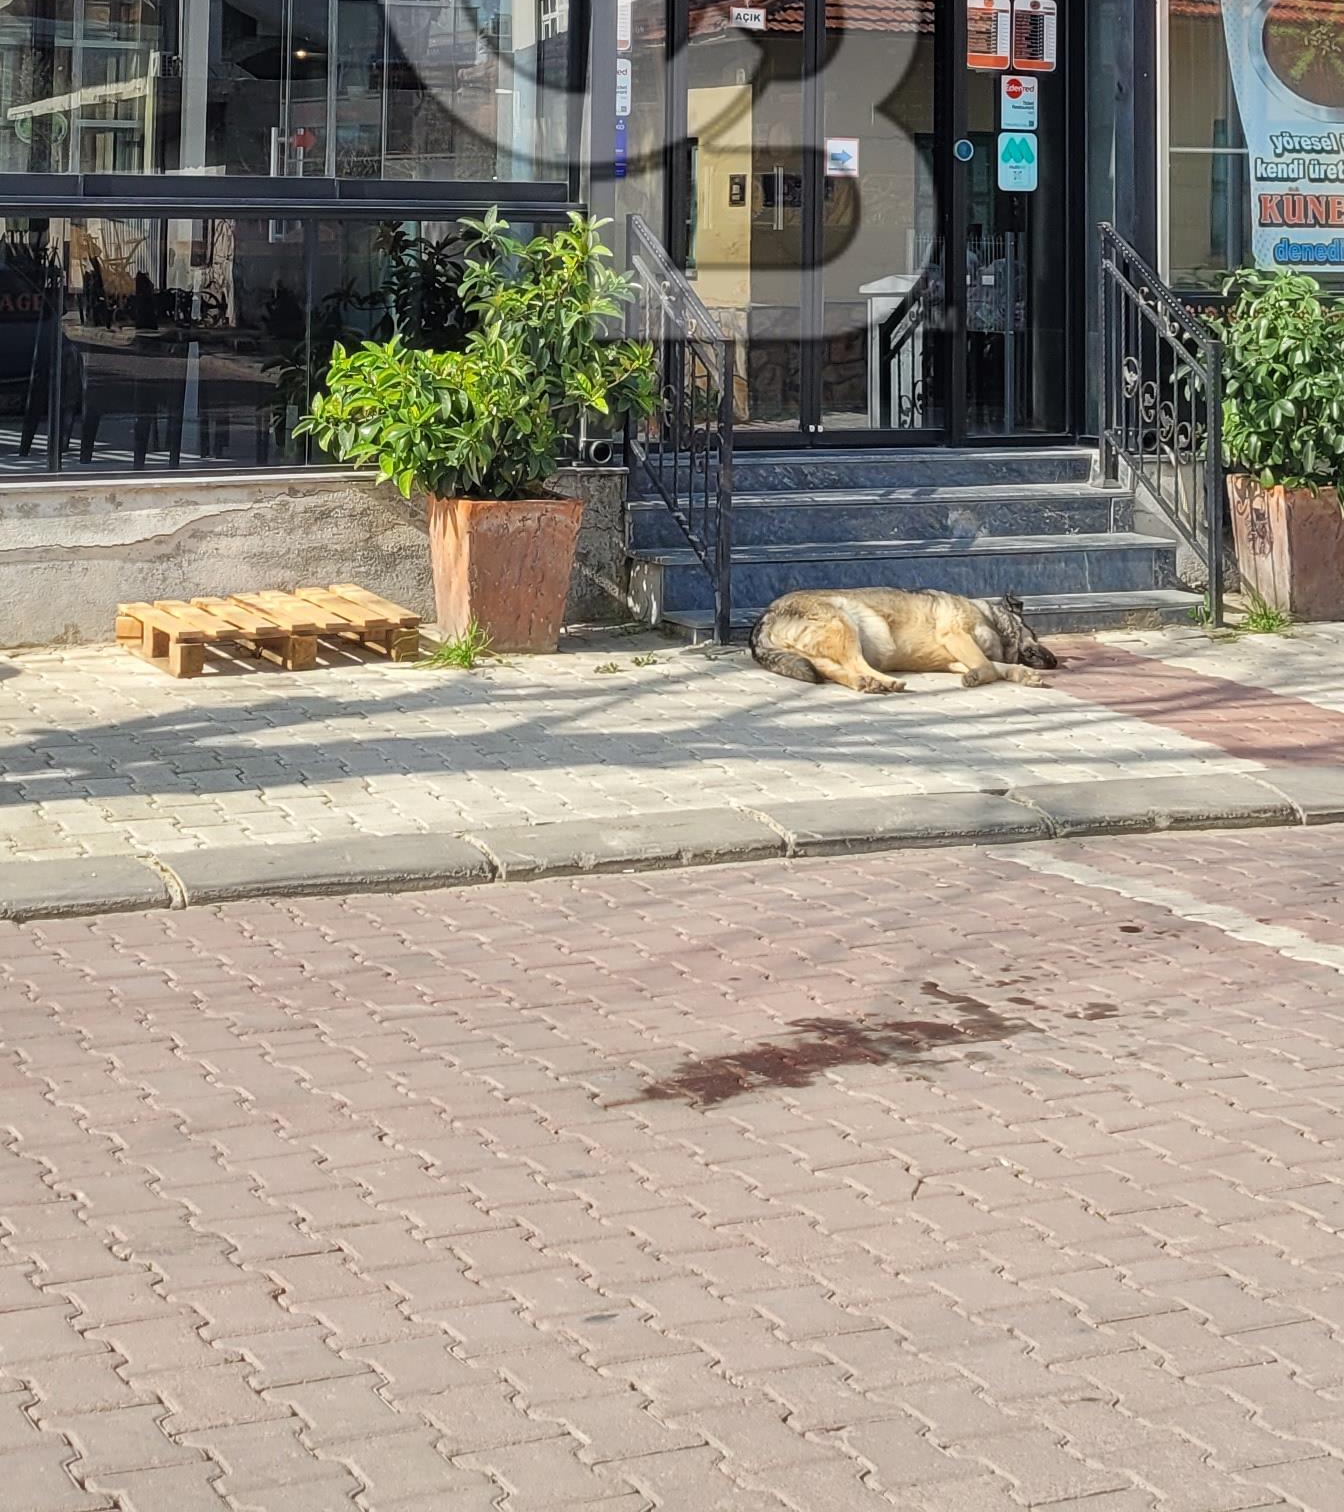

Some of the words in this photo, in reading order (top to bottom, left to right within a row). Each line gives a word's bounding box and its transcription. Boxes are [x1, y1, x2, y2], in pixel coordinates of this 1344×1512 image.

[734, 12, 762, 23] AÇIK
[1271, 132, 1337, 156] yöresel
[1256, 158, 1305, 183] kendi
